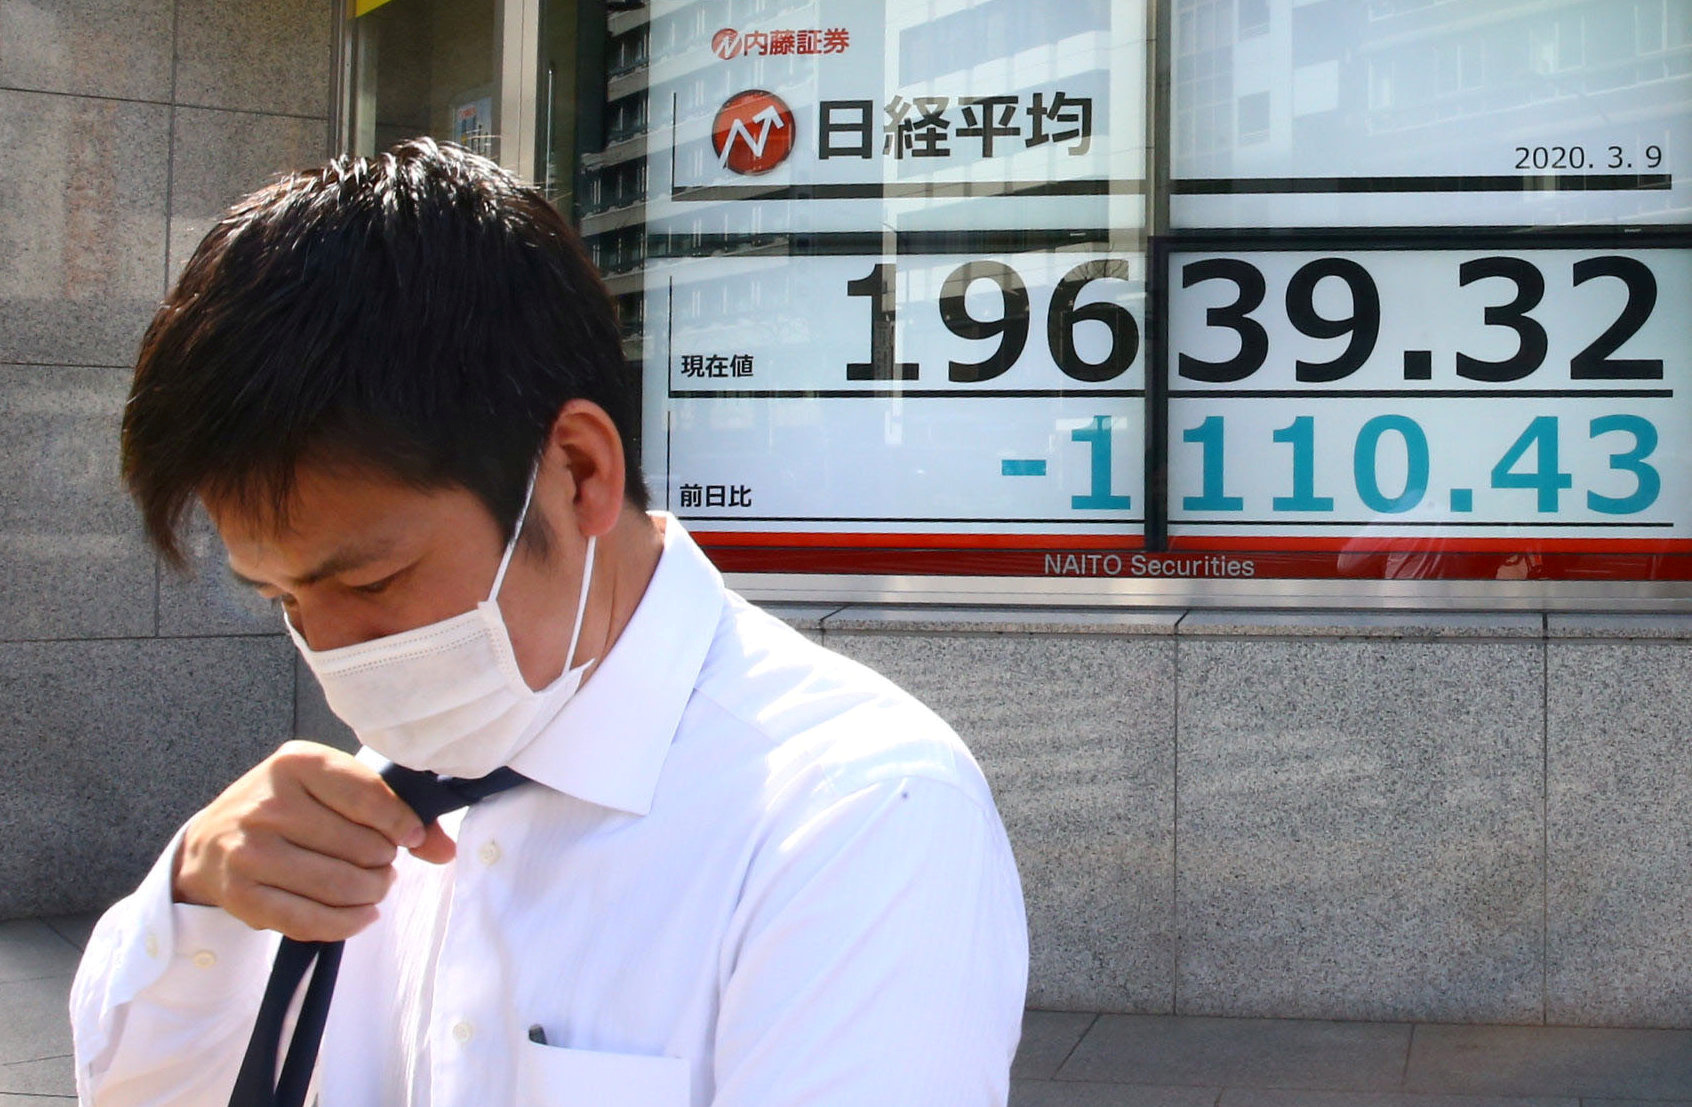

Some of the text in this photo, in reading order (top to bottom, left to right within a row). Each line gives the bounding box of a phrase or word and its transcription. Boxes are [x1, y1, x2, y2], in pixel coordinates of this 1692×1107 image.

[743, 28, 850, 56] 内藤証券
[818, 91, 1093, 160] 日経平均
[680, 354, 754, 378] 現在値
[679, 484, 753, 508] 前日比
[1044, 553, 1256, 577] NAITO Securities
